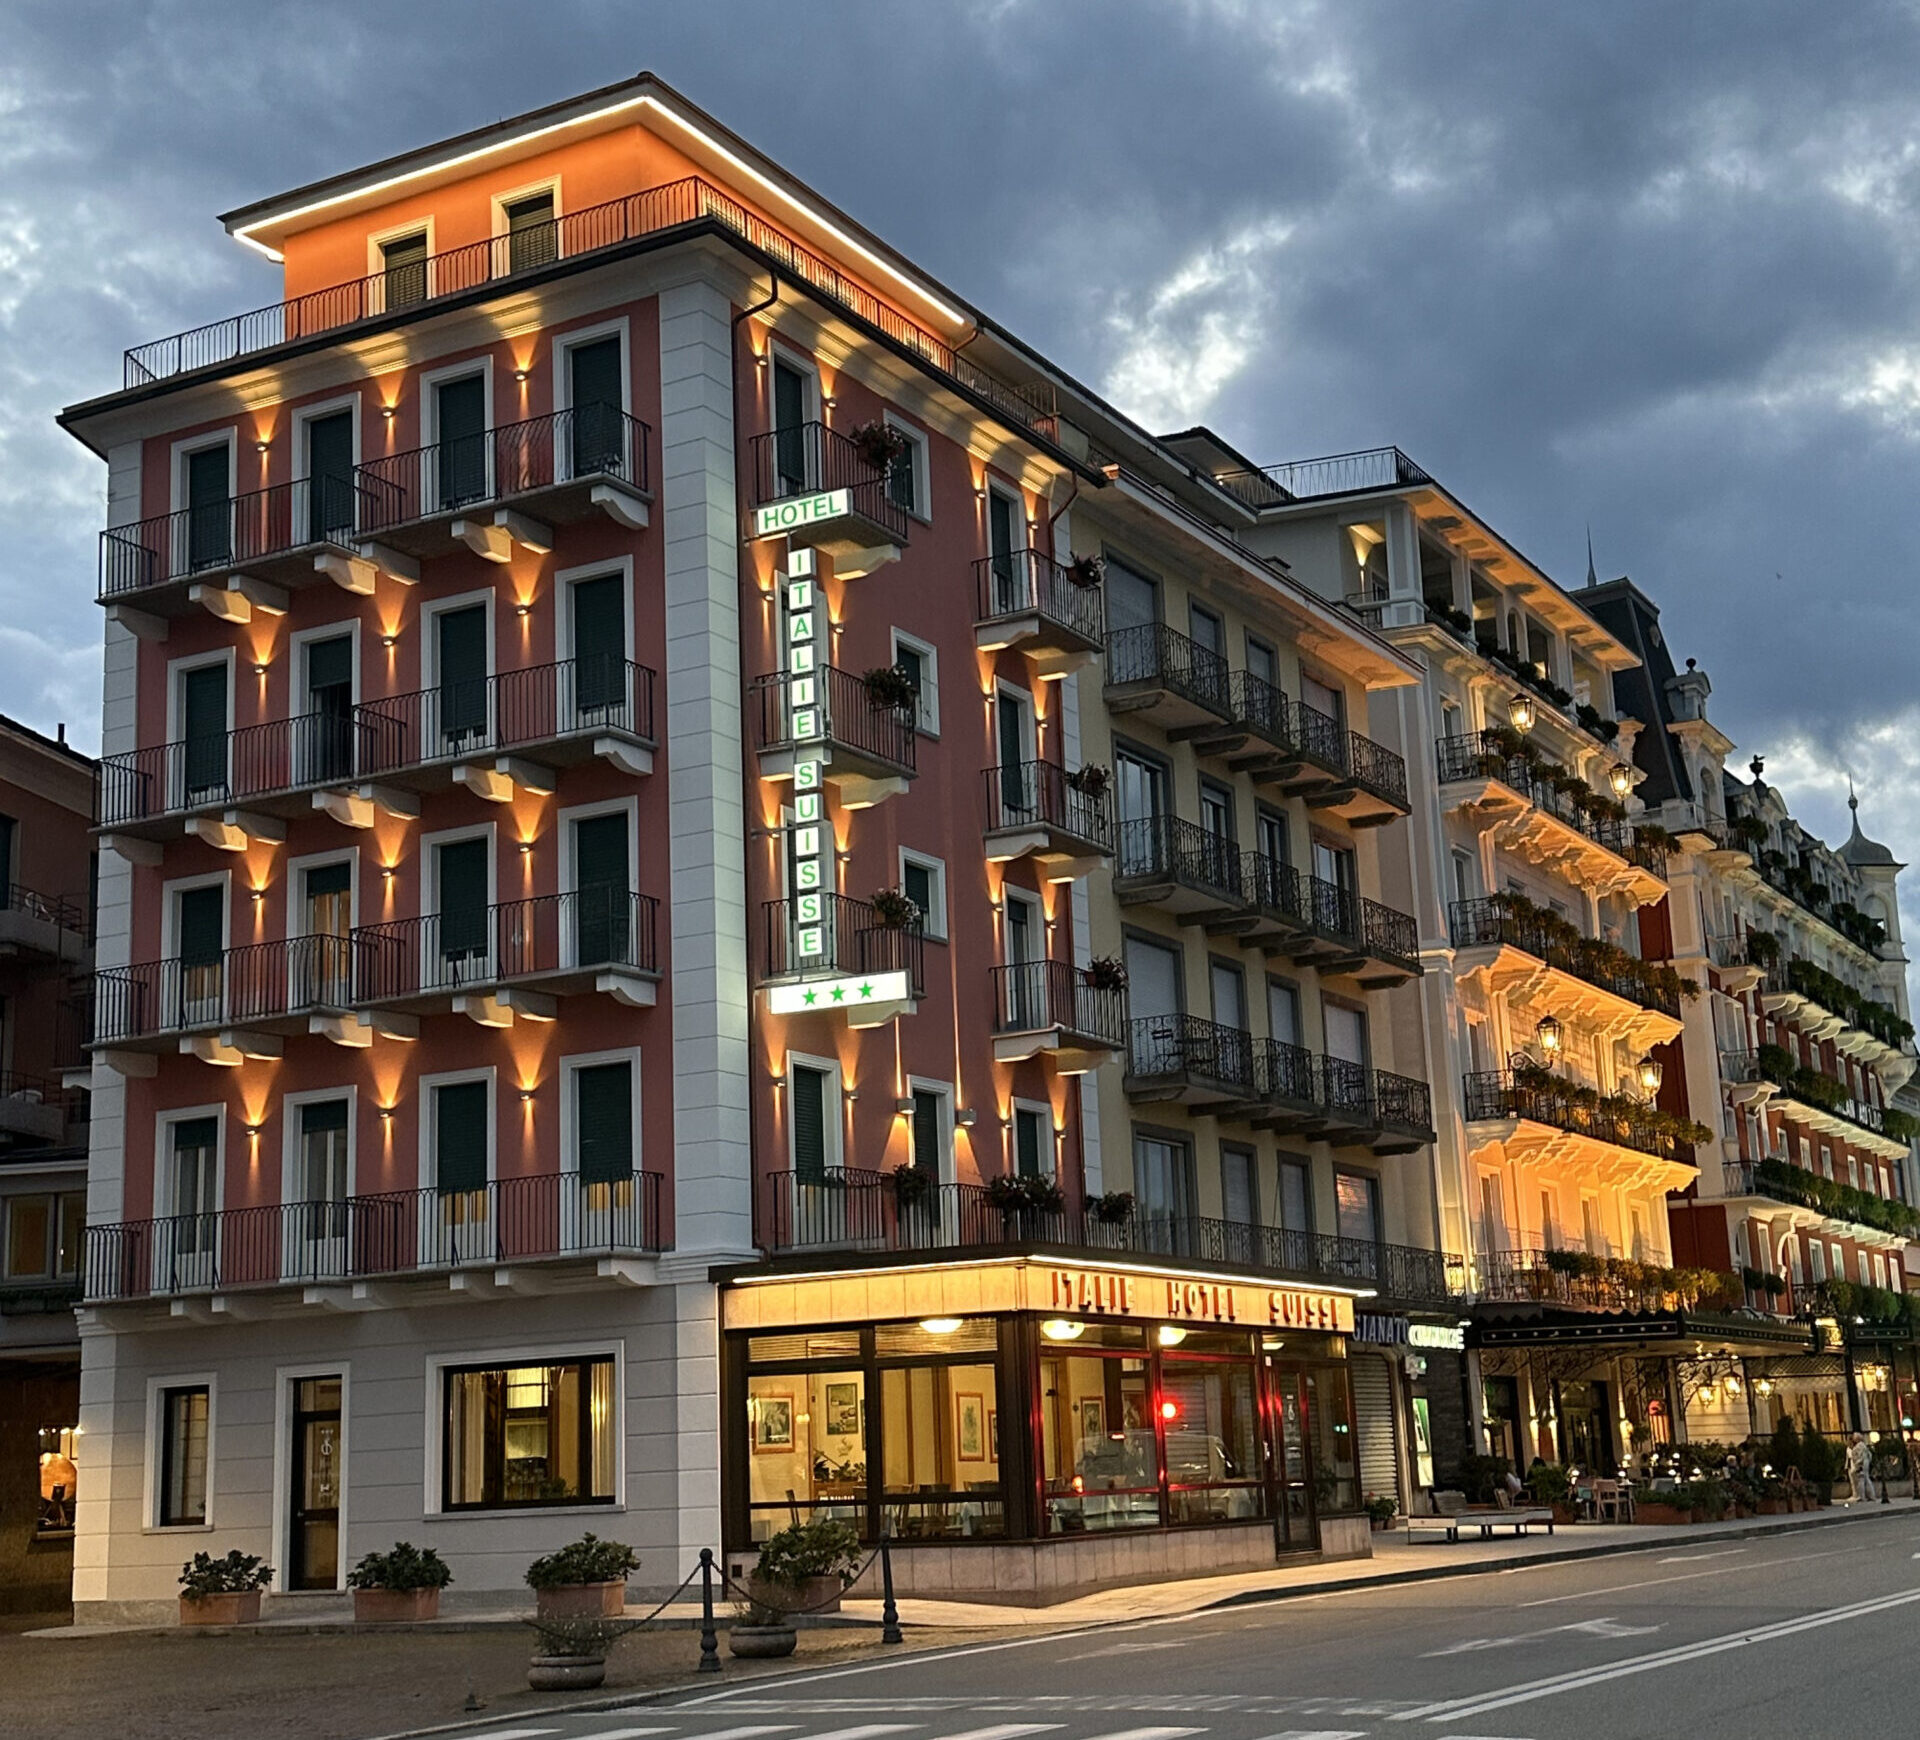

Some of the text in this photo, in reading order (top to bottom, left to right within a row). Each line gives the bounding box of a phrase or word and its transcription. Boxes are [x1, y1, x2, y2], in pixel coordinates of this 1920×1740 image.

[764, 494, 841, 529] HOTEL
[793, 553, 817, 952] ITALIE SUISSE
[1052, 1271, 1342, 1329] ITALIE HOTEL SUISSE
